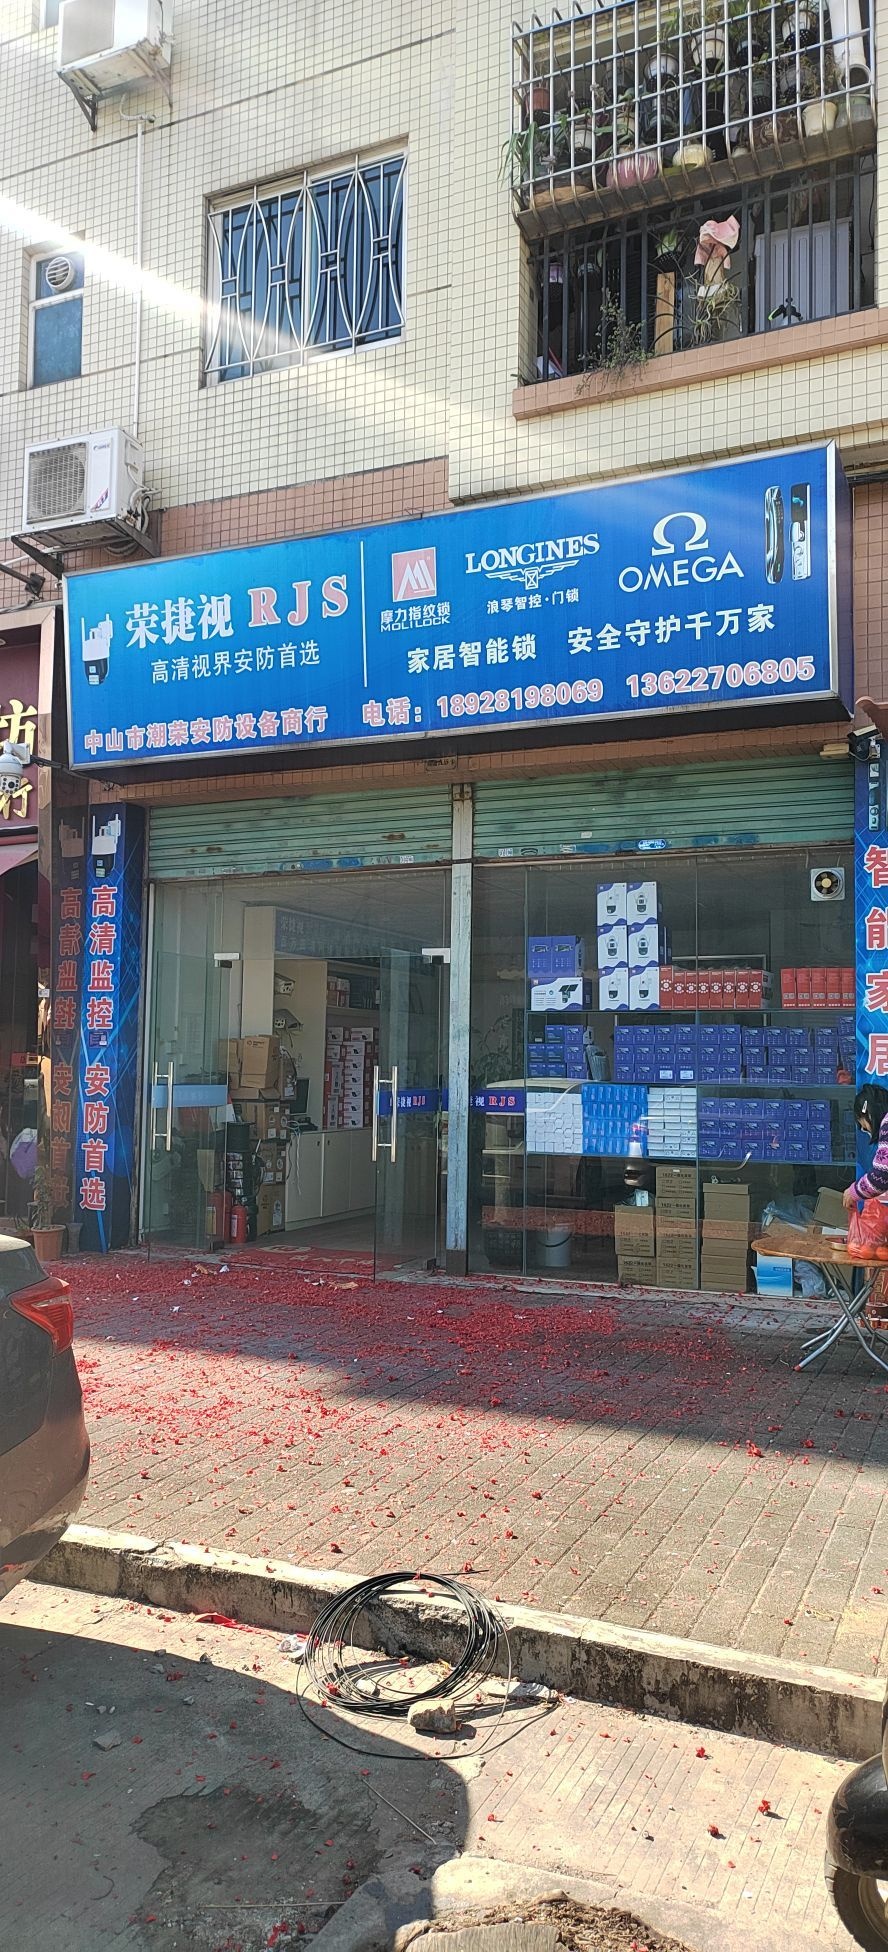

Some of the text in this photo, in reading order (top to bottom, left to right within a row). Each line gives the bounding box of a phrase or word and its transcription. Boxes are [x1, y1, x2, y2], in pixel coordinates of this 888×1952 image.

[465, 533, 600, 574] LONGINES
[618, 550, 745, 593] OMEGA
[125, 574, 349, 649] 荣捷视 RJS
[380, 601, 451, 624] 摩力指纹锁
[380, 615, 451, 632] MOLILOCK
[151, 639, 321, 684] 高清视界安防首选
[407, 603, 776, 674] 家居智能锁 安全守护千万家
[437, 678, 604, 718] 18928198069
[626, 655, 816, 698] 13622706805
[84, 705, 329, 755] 中山市潮荣安防设备商行
[86, 884, 117, 1030] 高清监控
[488, 1096, 516, 1107] RJS
[79, 1062, 110, 1211] 安防首选
